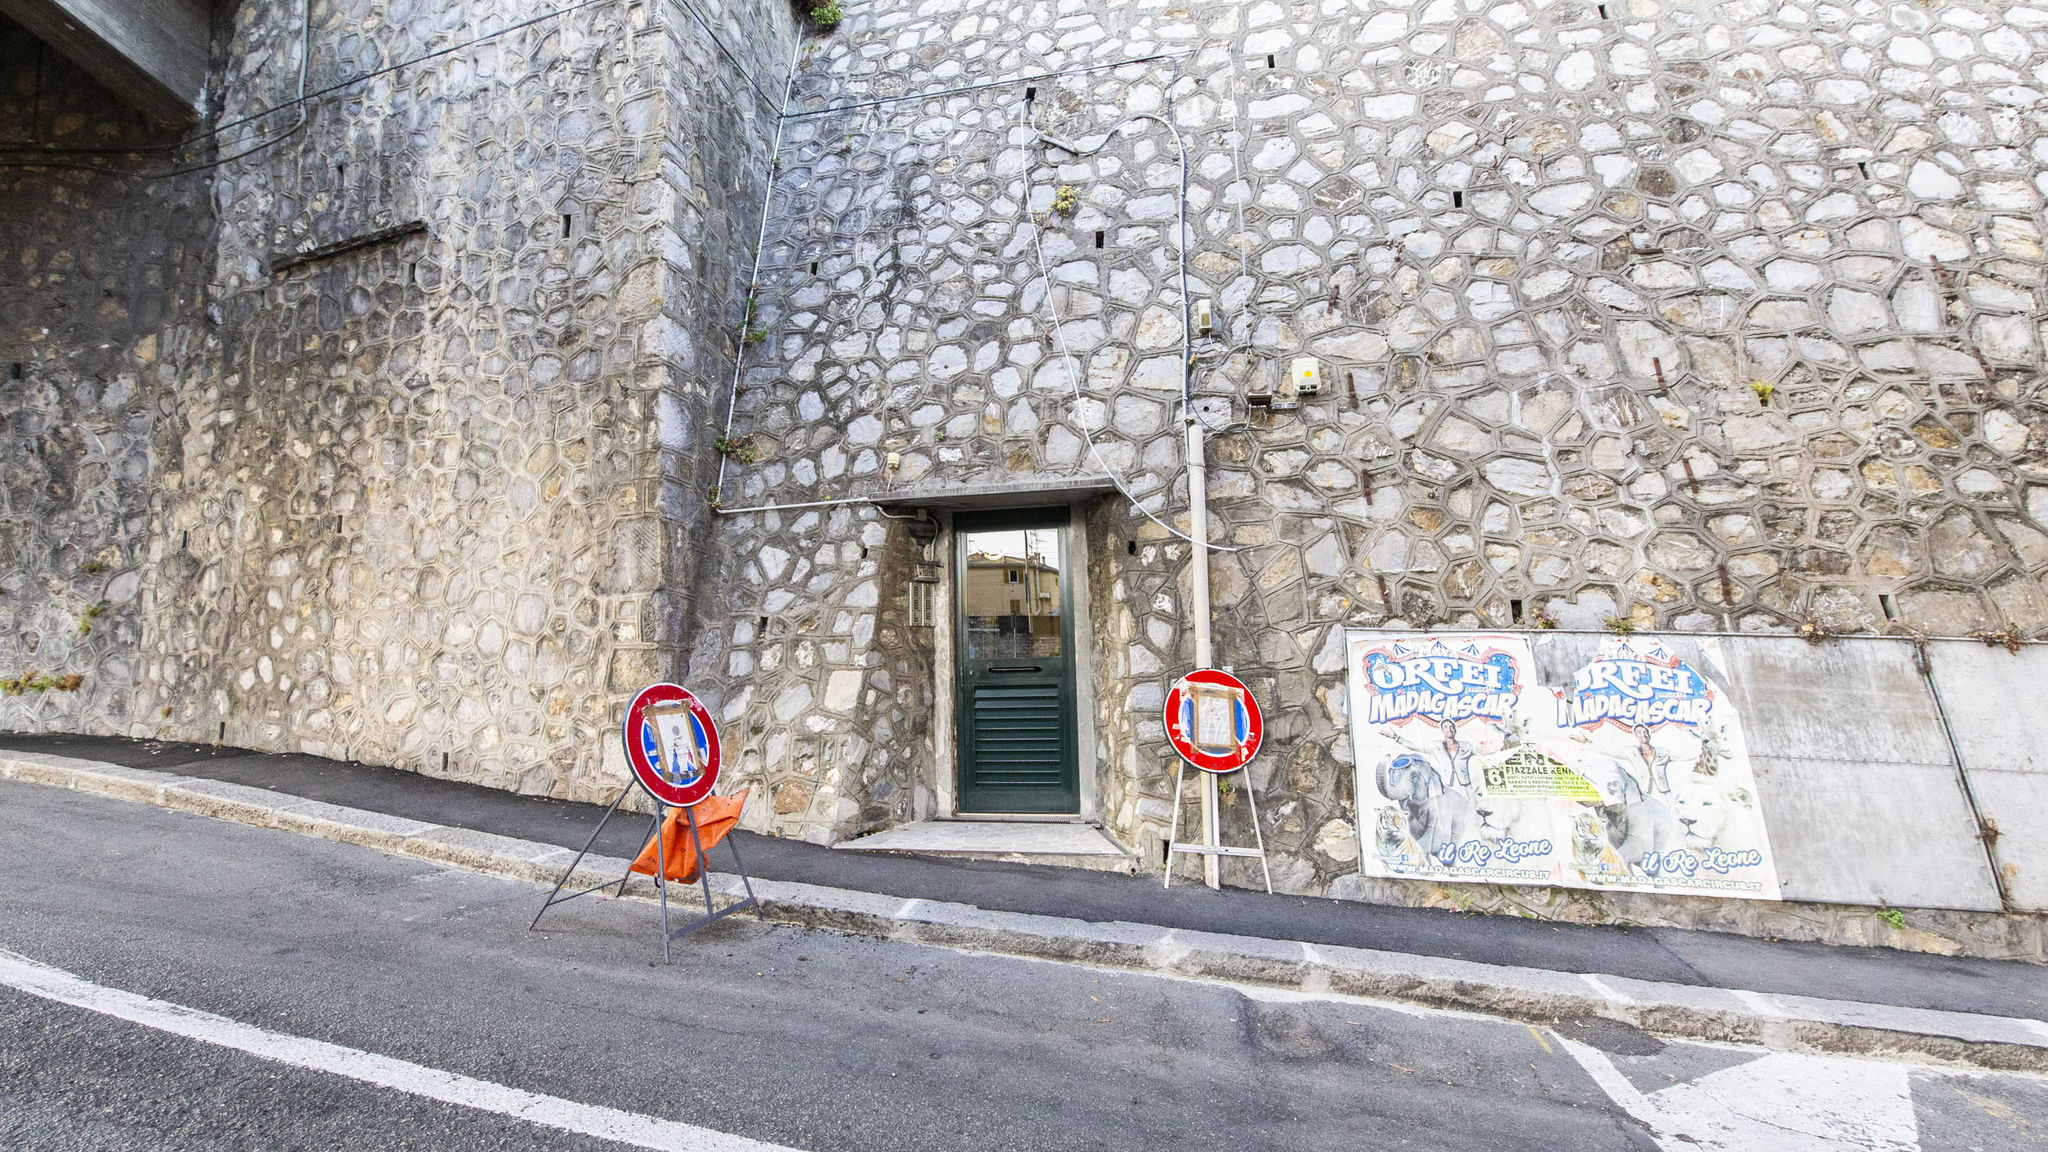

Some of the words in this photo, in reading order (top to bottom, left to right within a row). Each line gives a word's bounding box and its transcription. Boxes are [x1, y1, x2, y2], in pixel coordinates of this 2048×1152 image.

[1372, 657, 1503, 695] ORFEI
[1369, 690, 1518, 724] MADAGASCAR
[1438, 842, 1456, 864] il
[1458, 839, 1491, 867] Re
[1494, 837, 1553, 864] Leone
[1640, 850, 1660, 874] il
[1662, 849, 1699, 877] Re
[1702, 846, 1762, 875] Leone
